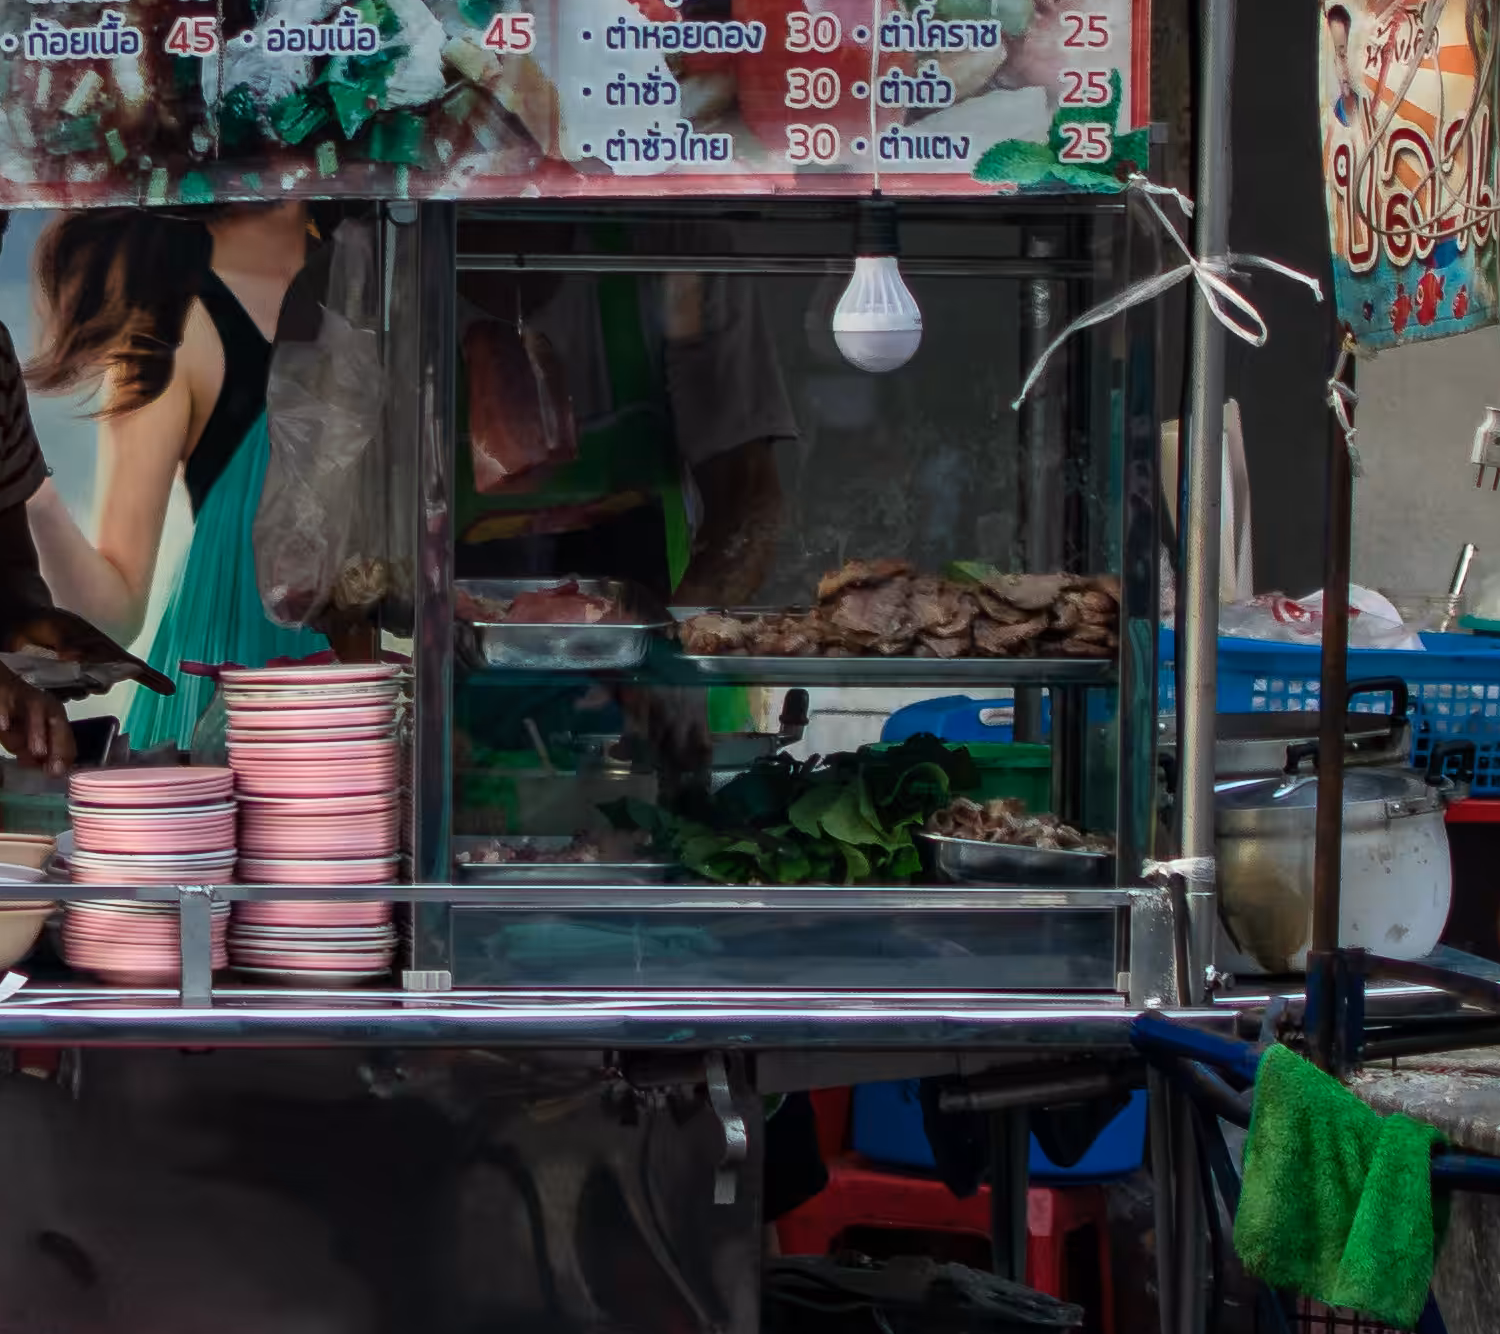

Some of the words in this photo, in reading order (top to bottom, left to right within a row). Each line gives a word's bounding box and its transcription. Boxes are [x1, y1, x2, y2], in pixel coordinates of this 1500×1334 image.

[28, 14, 139, 56] ก้อยเนื้อ
[167, 20, 216, 54] 45
[266, 9, 377, 52] อ่อมเนื้อ
[484, 17, 533, 51] 45
[605, 16, 764, 50] ตำหอยดอง
[789, 15, 837, 49] 30
[879, 10, 998, 48] ตำโคราช
[1062, 15, 1110, 48] 25
[605, 65, 678, 106] ตำซั่ว
[789, 71, 837, 105] 30
[879, 62, 952, 104] ตำถั่ว
[1062, 71, 1110, 105] 25
[605, 121, 729, 162] ตำซั่วไทย
[789, 127, 836, 161] 30
[878, 126, 971, 160] ตำแตง
[1061, 126, 1109, 160] 25
